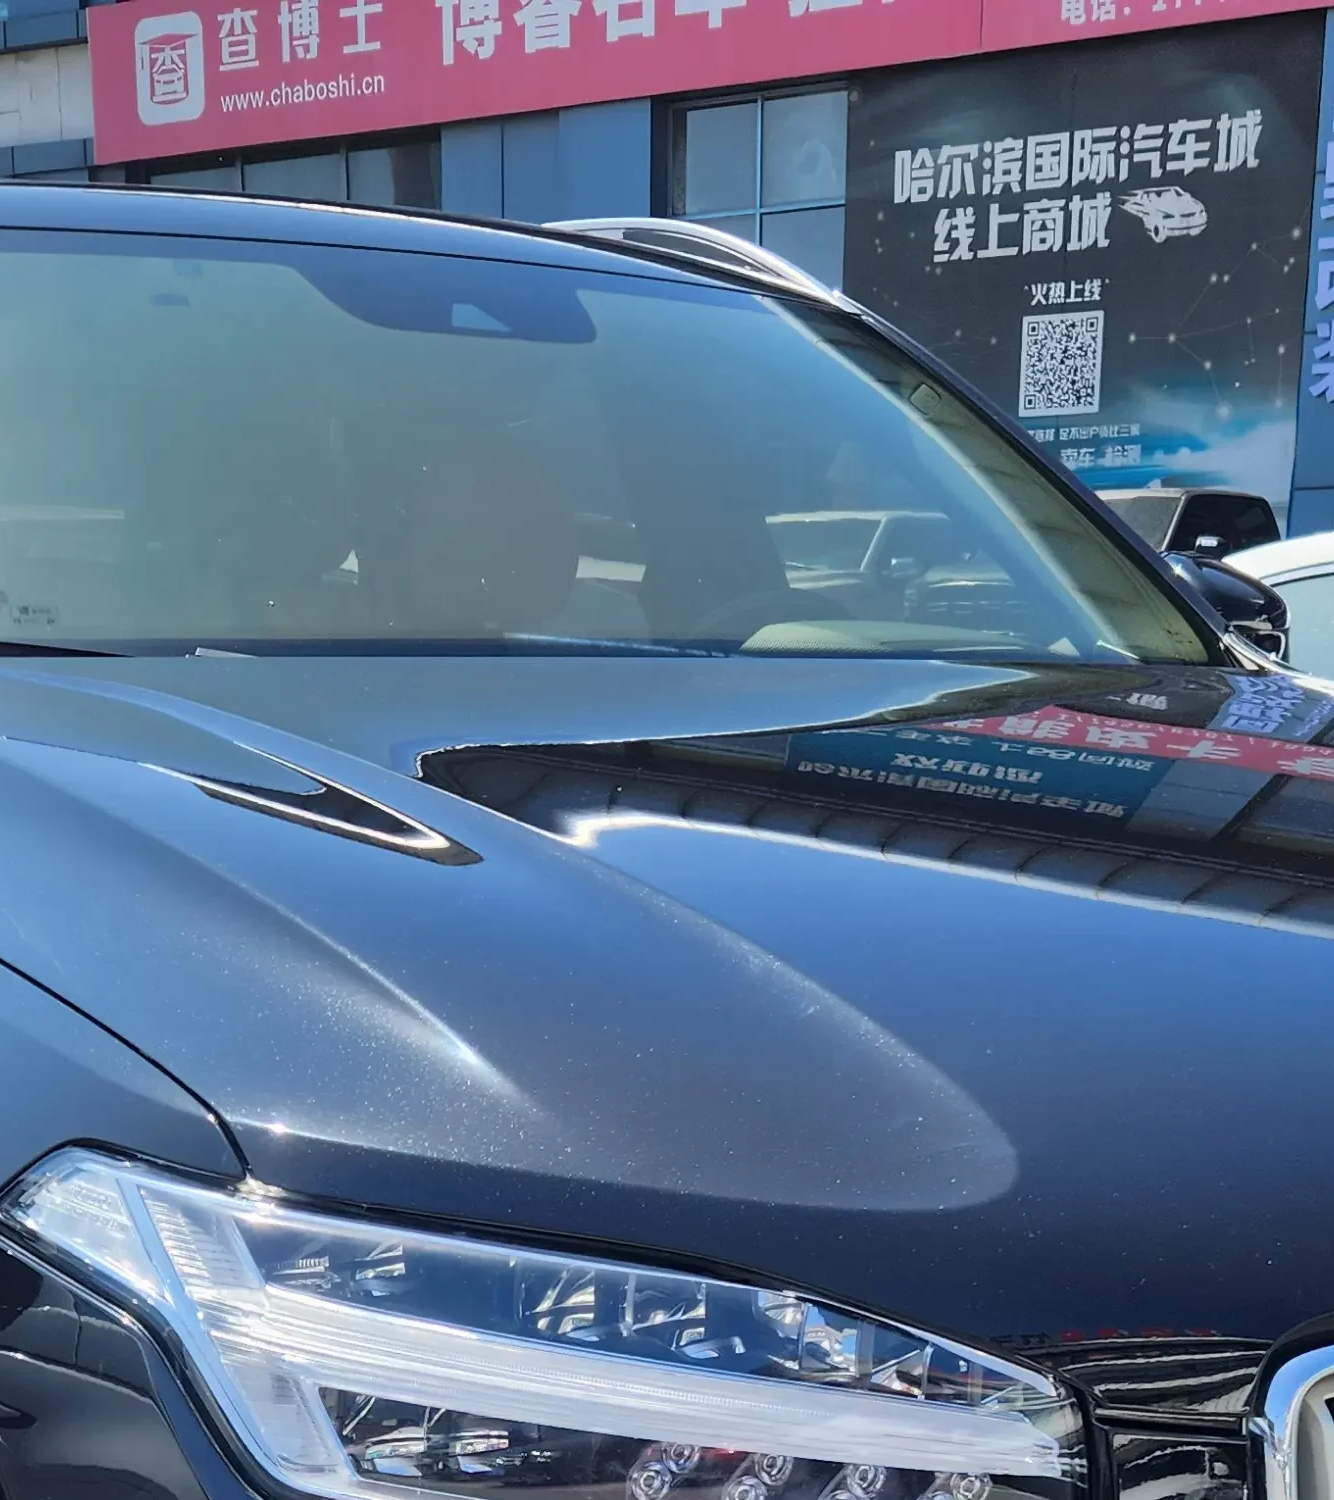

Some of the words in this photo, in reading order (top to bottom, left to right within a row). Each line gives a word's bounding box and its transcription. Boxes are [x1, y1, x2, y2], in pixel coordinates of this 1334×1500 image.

[217, 0, 384, 72] 查博士
[220, 73, 385, 113] www.chaboshi.cn
[893, 109, 1263, 204] 哈尔滨国际汽车城
[933, 191, 1113, 263] 线上商城
[1030, 278, 1103, 306] 火热上线
